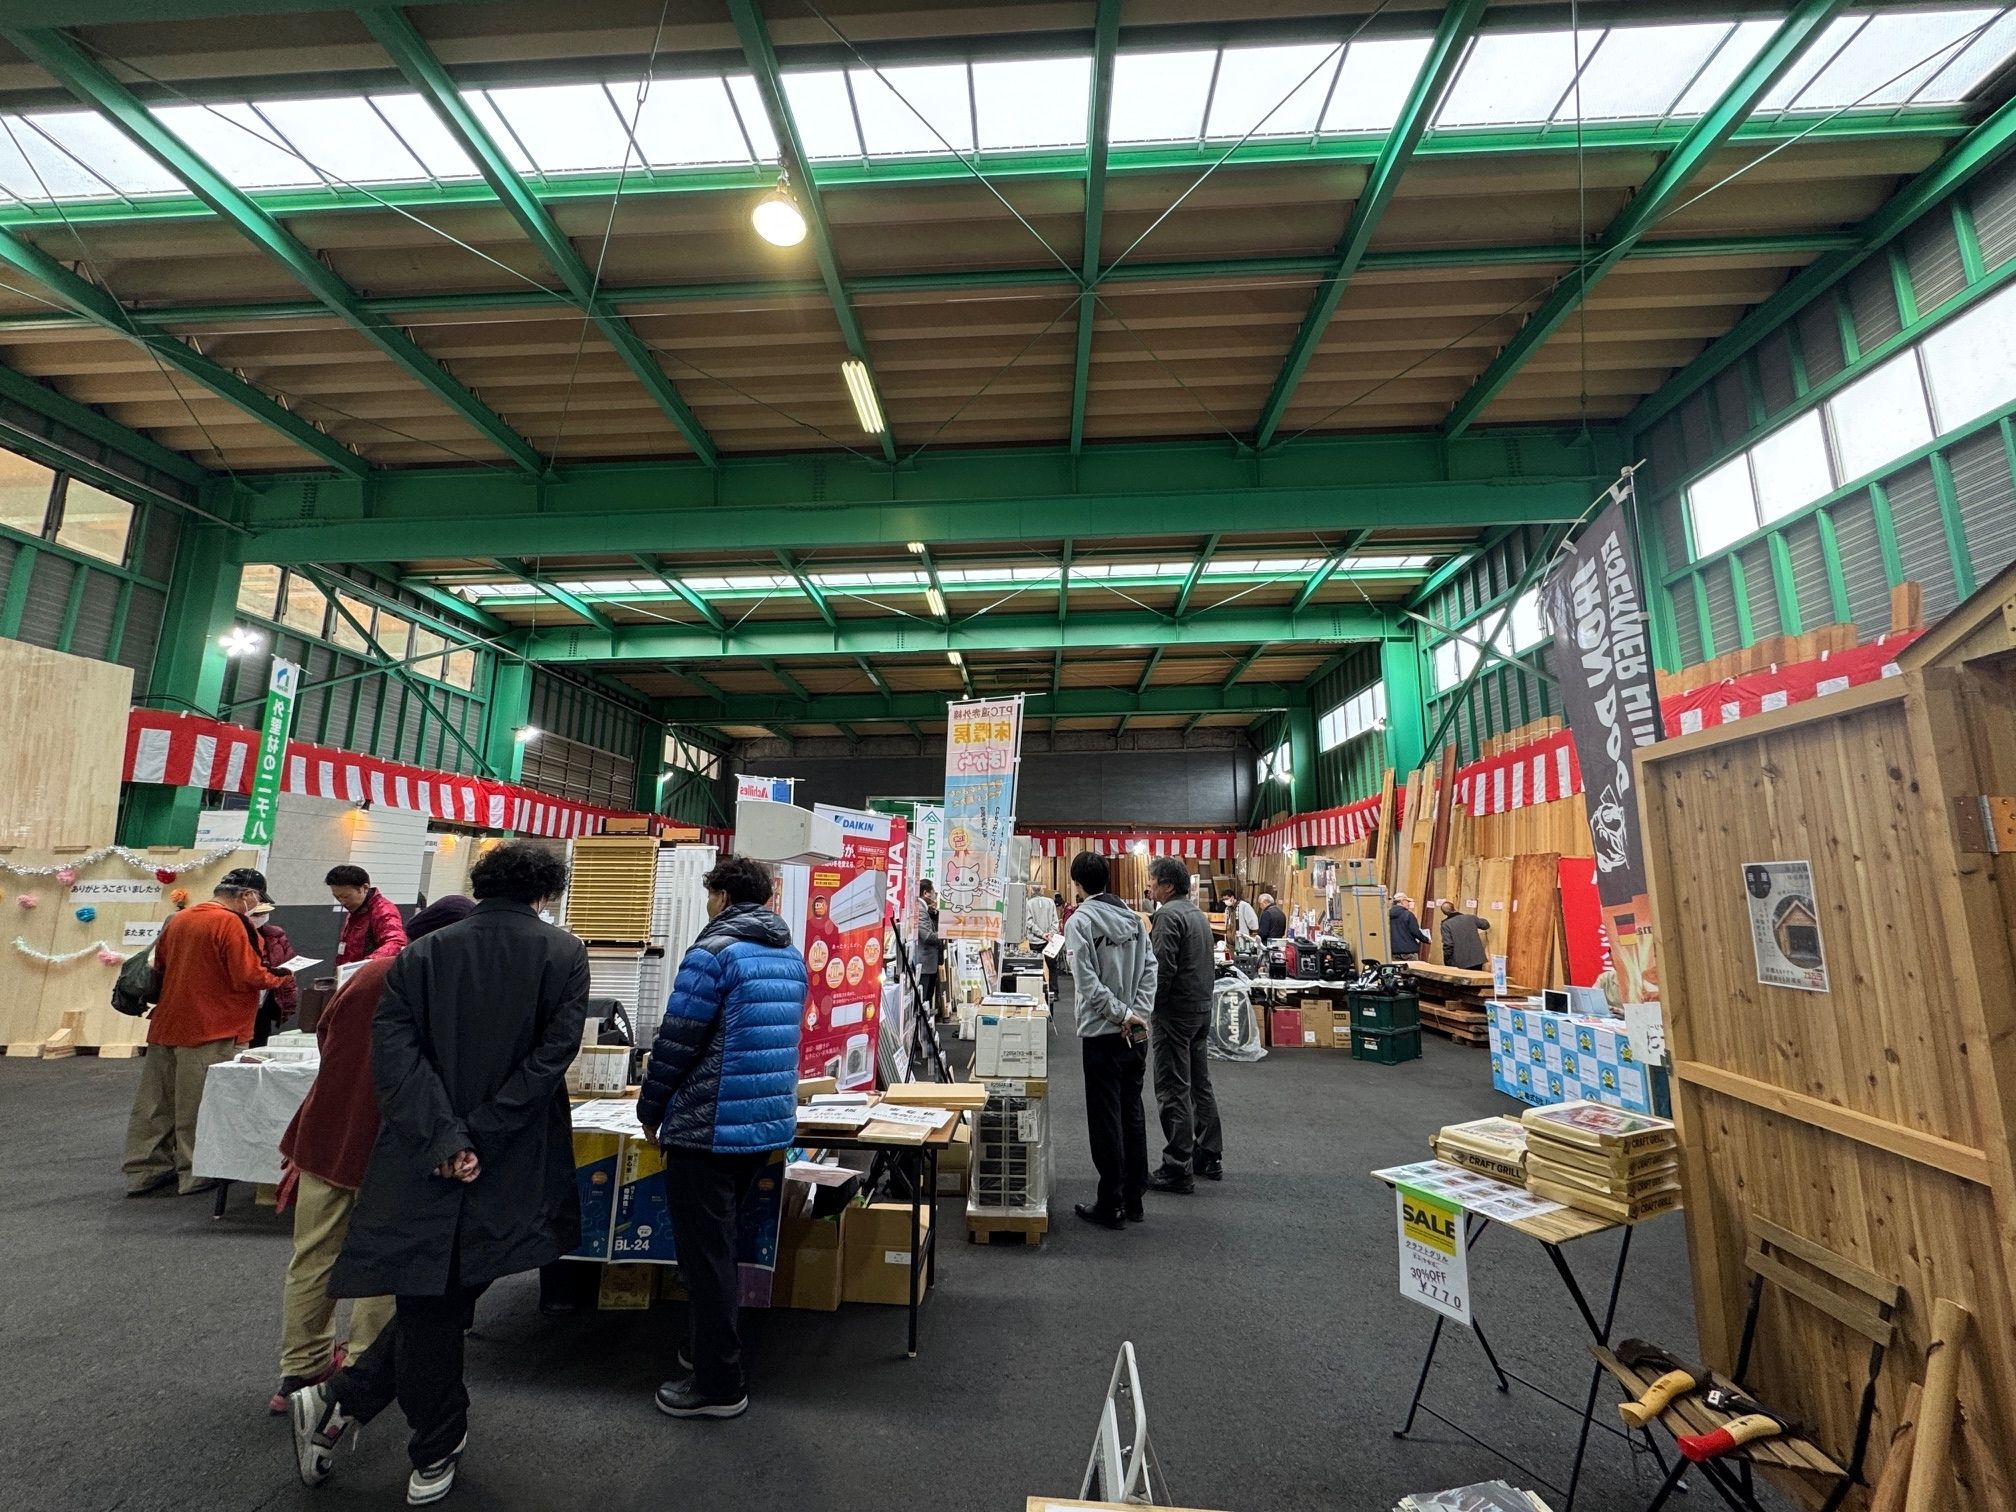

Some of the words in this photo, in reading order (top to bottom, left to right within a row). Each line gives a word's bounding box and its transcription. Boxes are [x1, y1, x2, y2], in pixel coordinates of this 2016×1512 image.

[842, 819, 875, 832] DAIKIN
[1228, 992, 1240, 1044] Admiral
[1632, 1136, 1648, 1148] CRAFT
[1650, 1132, 1665, 1144] GRILL
[1468, 1155, 1496, 1170] CRAFT
[1496, 1164, 1521, 1178] GRILL
[1640, 1201, 1658, 1213] CRAFT
[1403, 1203, 1455, 1240] SALE
[1406, 1240, 1448, 1263] クラフトグリル
[1410, 1266, 1447, 1285] 30%OFF
